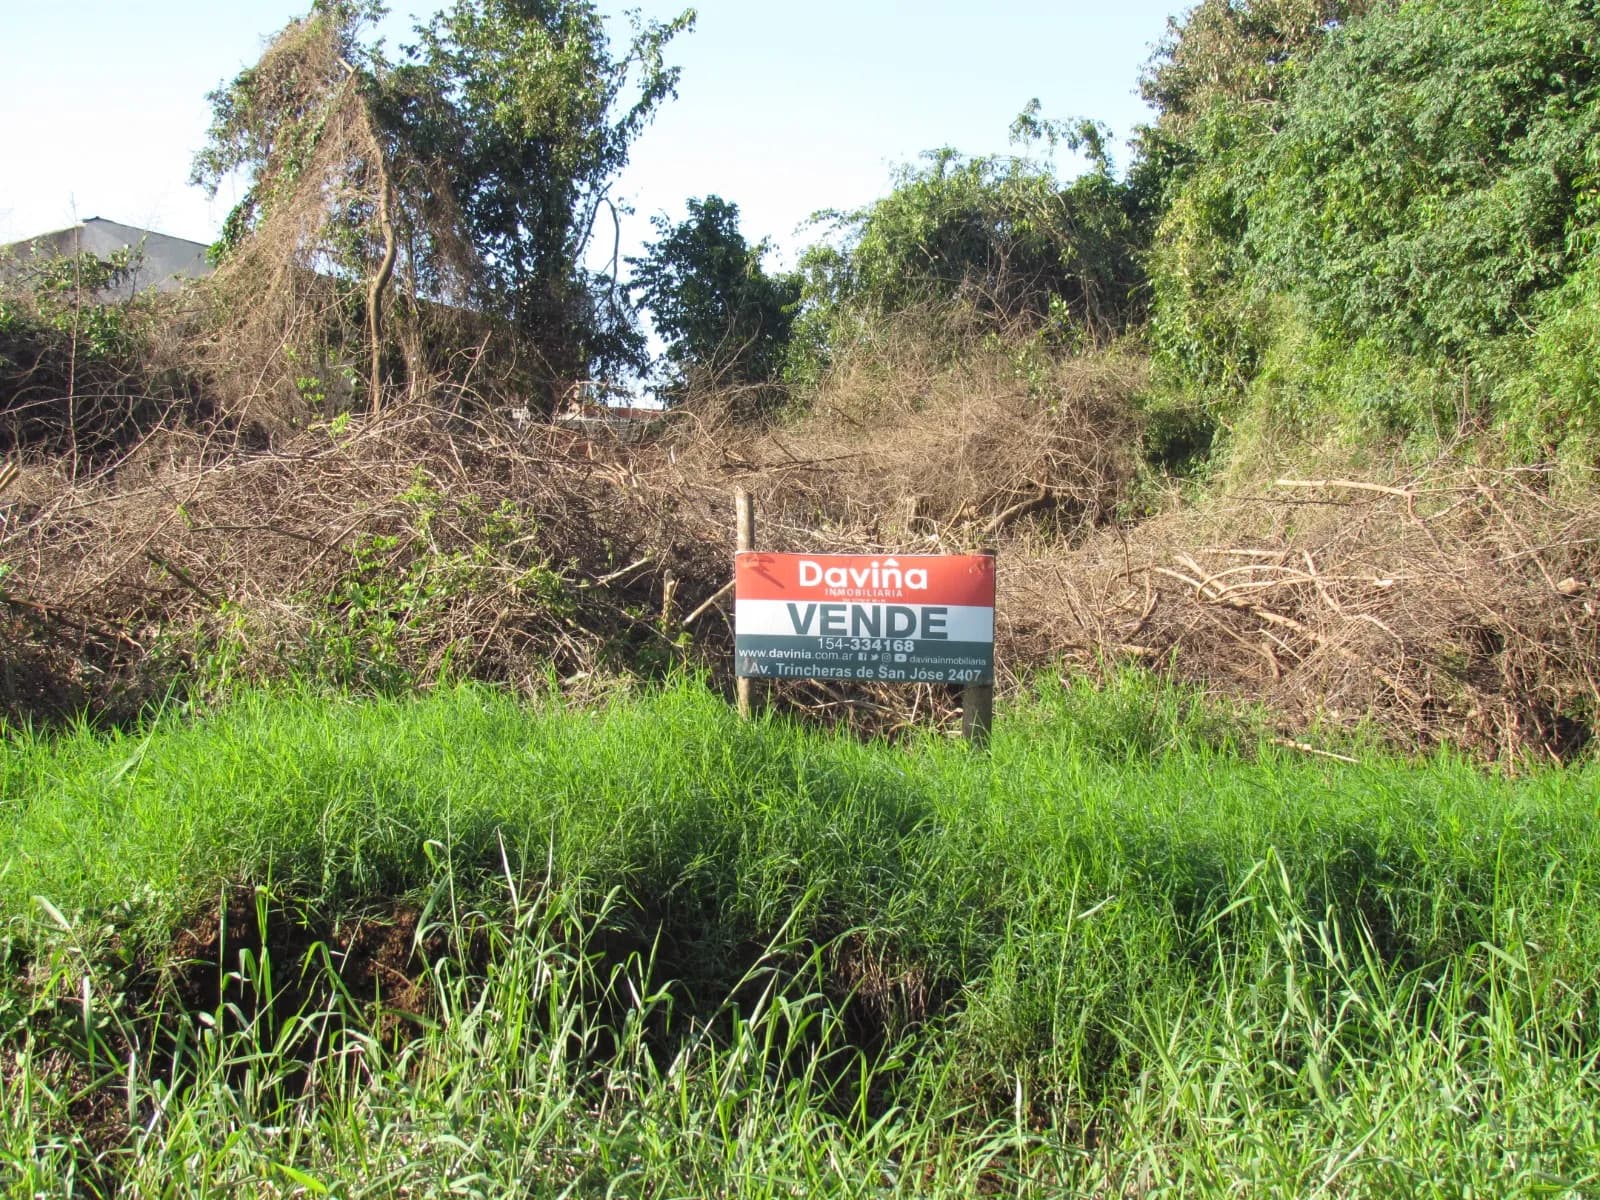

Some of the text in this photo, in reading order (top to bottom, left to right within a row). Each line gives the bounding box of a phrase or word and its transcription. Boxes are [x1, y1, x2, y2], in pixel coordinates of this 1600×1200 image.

[824, 588, 904, 598] INMOBILIARIA
[787, 602, 949, 640] VENDE
[818, 638, 915, 652] 154-334168
[738, 648, 853, 660] www.davinia.com.ar
[750, 662, 771, 674] Av.
[776, 663, 852, 677] Trincheras
[856, 666, 874, 678] de
[878, 667, 905, 679] San
[948, 669, 982, 681] 2407
